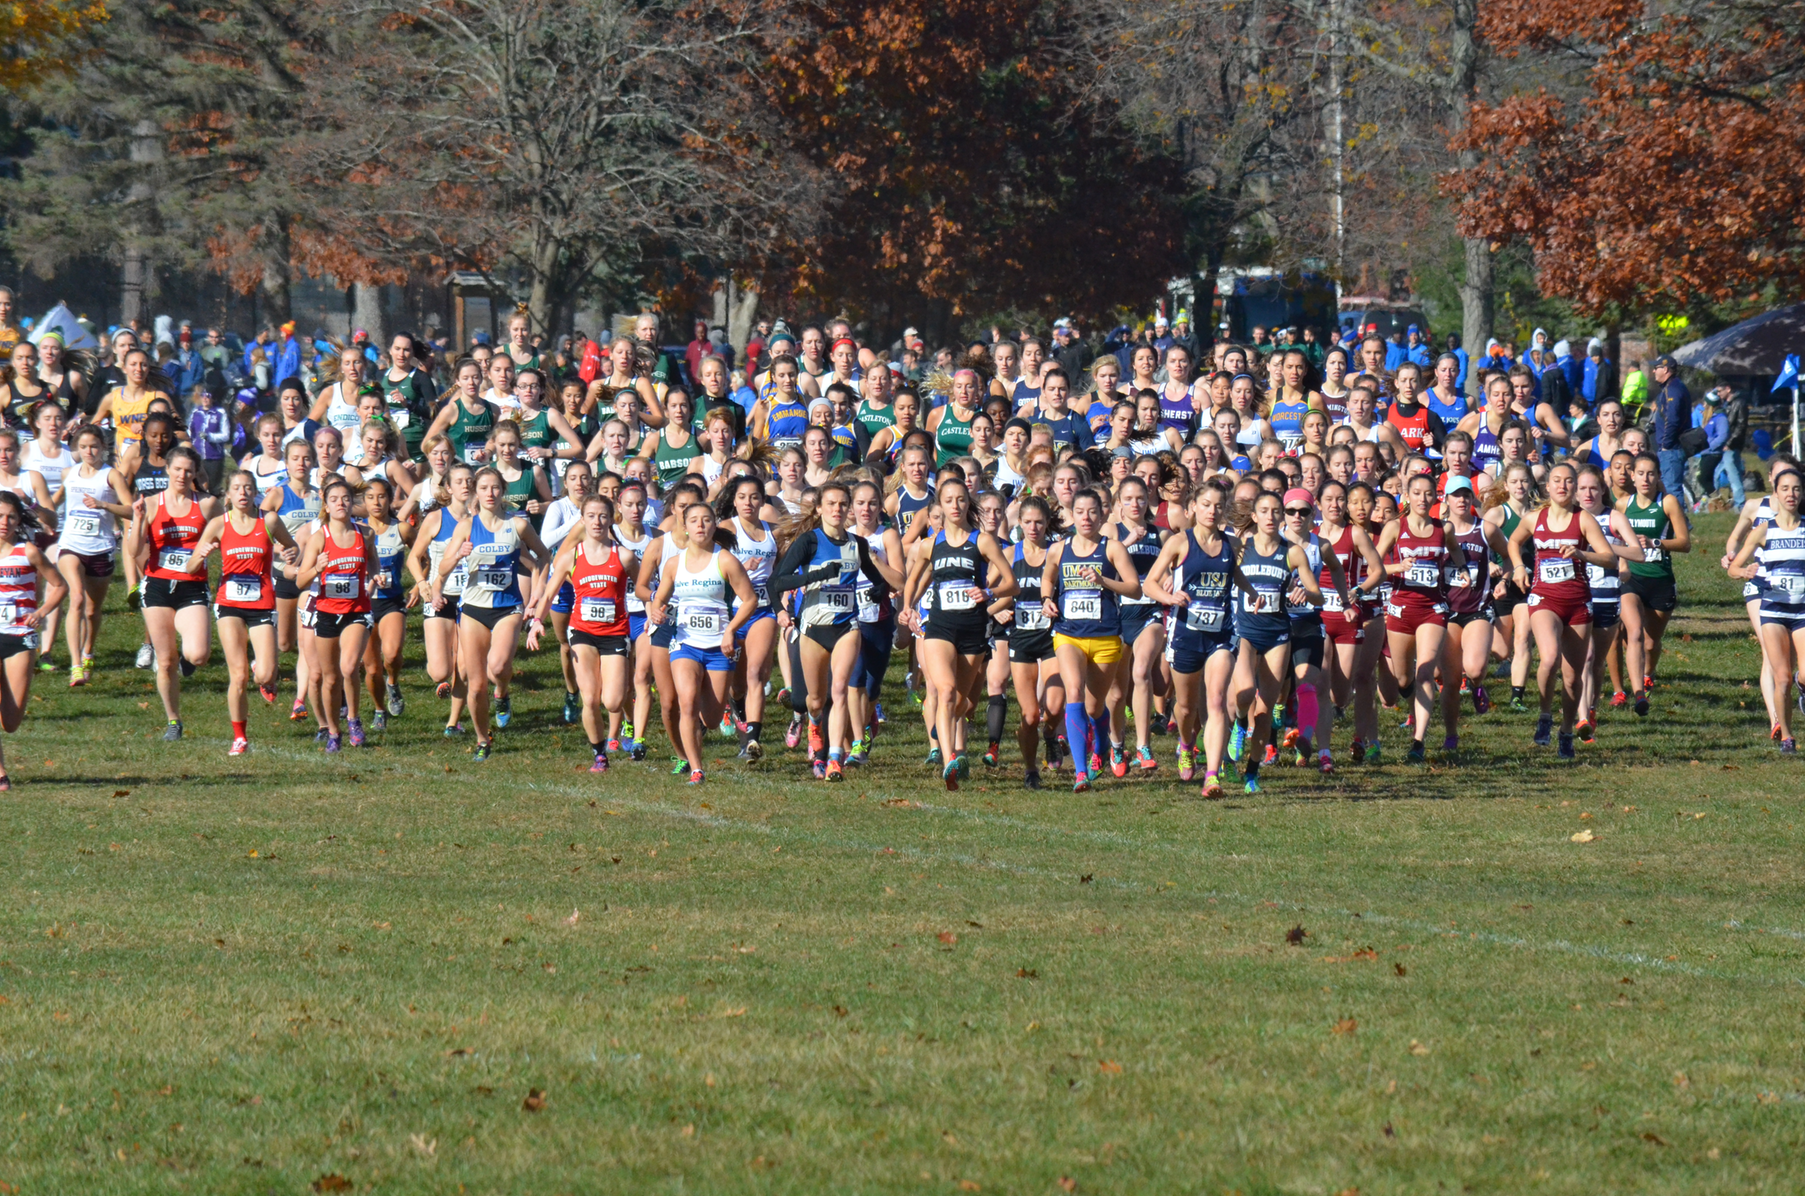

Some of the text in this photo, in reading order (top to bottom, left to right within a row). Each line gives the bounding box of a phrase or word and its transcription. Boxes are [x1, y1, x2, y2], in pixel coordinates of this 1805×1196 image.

[120, 413, 147, 424] WNE
[333, 414, 360, 422] ENDICO
[772, 409, 808, 422] EMMANUE
[859, 412, 892, 425] ASTLETON
[1160, 411, 1193, 419] HERST
[1272, 412, 1304, 422] WORCEST
[941, 426, 971, 436] CASTLET
[1400, 428, 1425, 438] ARK
[659, 457, 693, 470] BABSO
[74, 518, 94, 531] 725
[479, 545, 511, 553] COLBY
[1534, 538, 1579, 549] MIT
[1771, 539, 1805, 549] BRANDEI
[226, 547, 264, 556] BRIDGEWATER
[1400, 546, 1444, 558] MIT
[934, 556, 975, 571] UNE
[1063, 565, 1102, 578] UMS
[1241, 564, 1289, 581] DDLEBURY
[1411, 570, 1434, 582] 513
[1546, 566, 1568, 579] 521
[484, 573, 506, 586] 162
[579, 575, 618, 585] BRIDGEWATER
[675, 578, 723, 588] alve Regina
[1201, 572, 1228, 587] USJ
[1780, 577, 1794, 589] 81
[236, 583, 251, 596] 97
[335, 582, 351, 594] 98
[826, 593, 848, 607] 160
[1070, 600, 1094, 613] 840
[690, 616, 713, 628] 656
[1021, 610, 1042, 624] 817
[1194, 611, 1218, 625] 737
